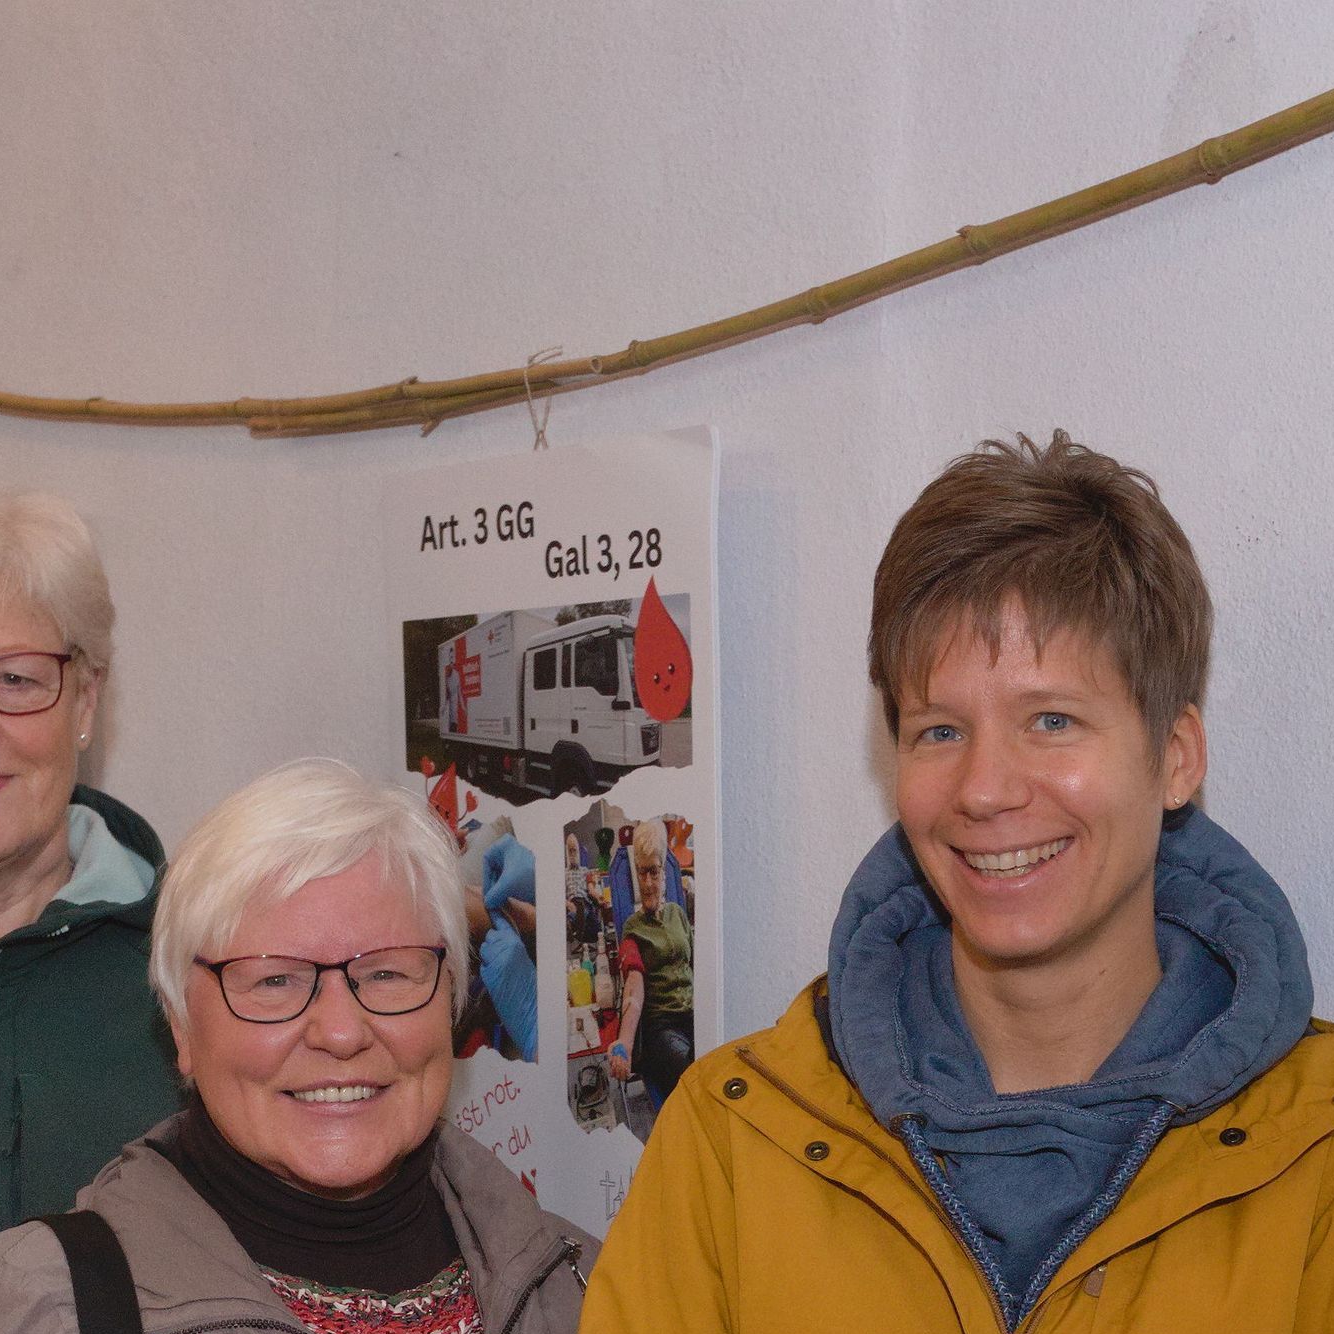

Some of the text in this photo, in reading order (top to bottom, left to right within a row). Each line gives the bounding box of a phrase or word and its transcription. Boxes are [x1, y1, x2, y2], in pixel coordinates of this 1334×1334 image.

[420, 500, 535, 552] Art. 3 GG
[544, 527, 663, 582] Gal 3, 28
[483, 1073, 521, 1117] rot.
[508, 1124, 532, 1156] du
